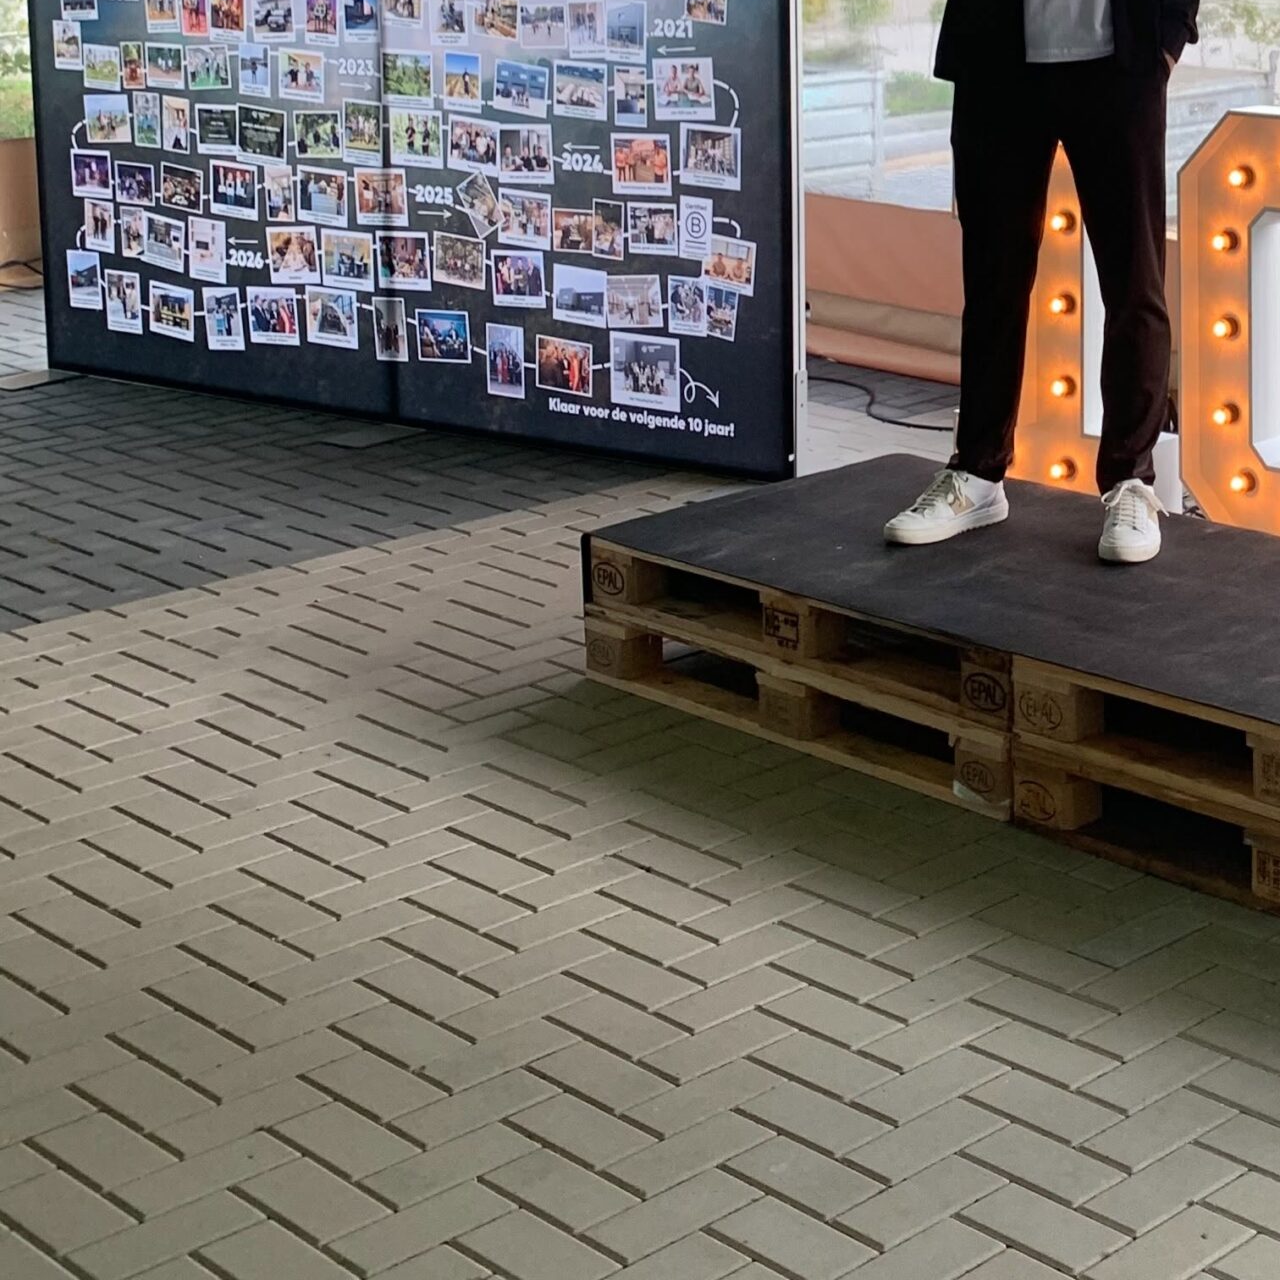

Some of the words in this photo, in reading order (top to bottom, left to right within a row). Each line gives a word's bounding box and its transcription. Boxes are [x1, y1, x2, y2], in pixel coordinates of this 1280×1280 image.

[653, 19, 693, 38] 2021
[338, 58, 374, 77] 2023
[562, 151, 604, 173] 2024
[415, 184, 453, 206] 2025
[229, 249, 264, 270] 2026
[549, 397, 581, 415] Klaar
[583, 404, 610, 419] voor
[612, 407, 628, 422] de
[629, 410, 686, 430] volgende
[687, 417, 702, 433] 10
[703, 420, 735, 438] jaar!
[597, 567, 620, 591] EPAL
[969, 682, 1004, 708] EPAL
[966, 765, 991, 787] EPAL
